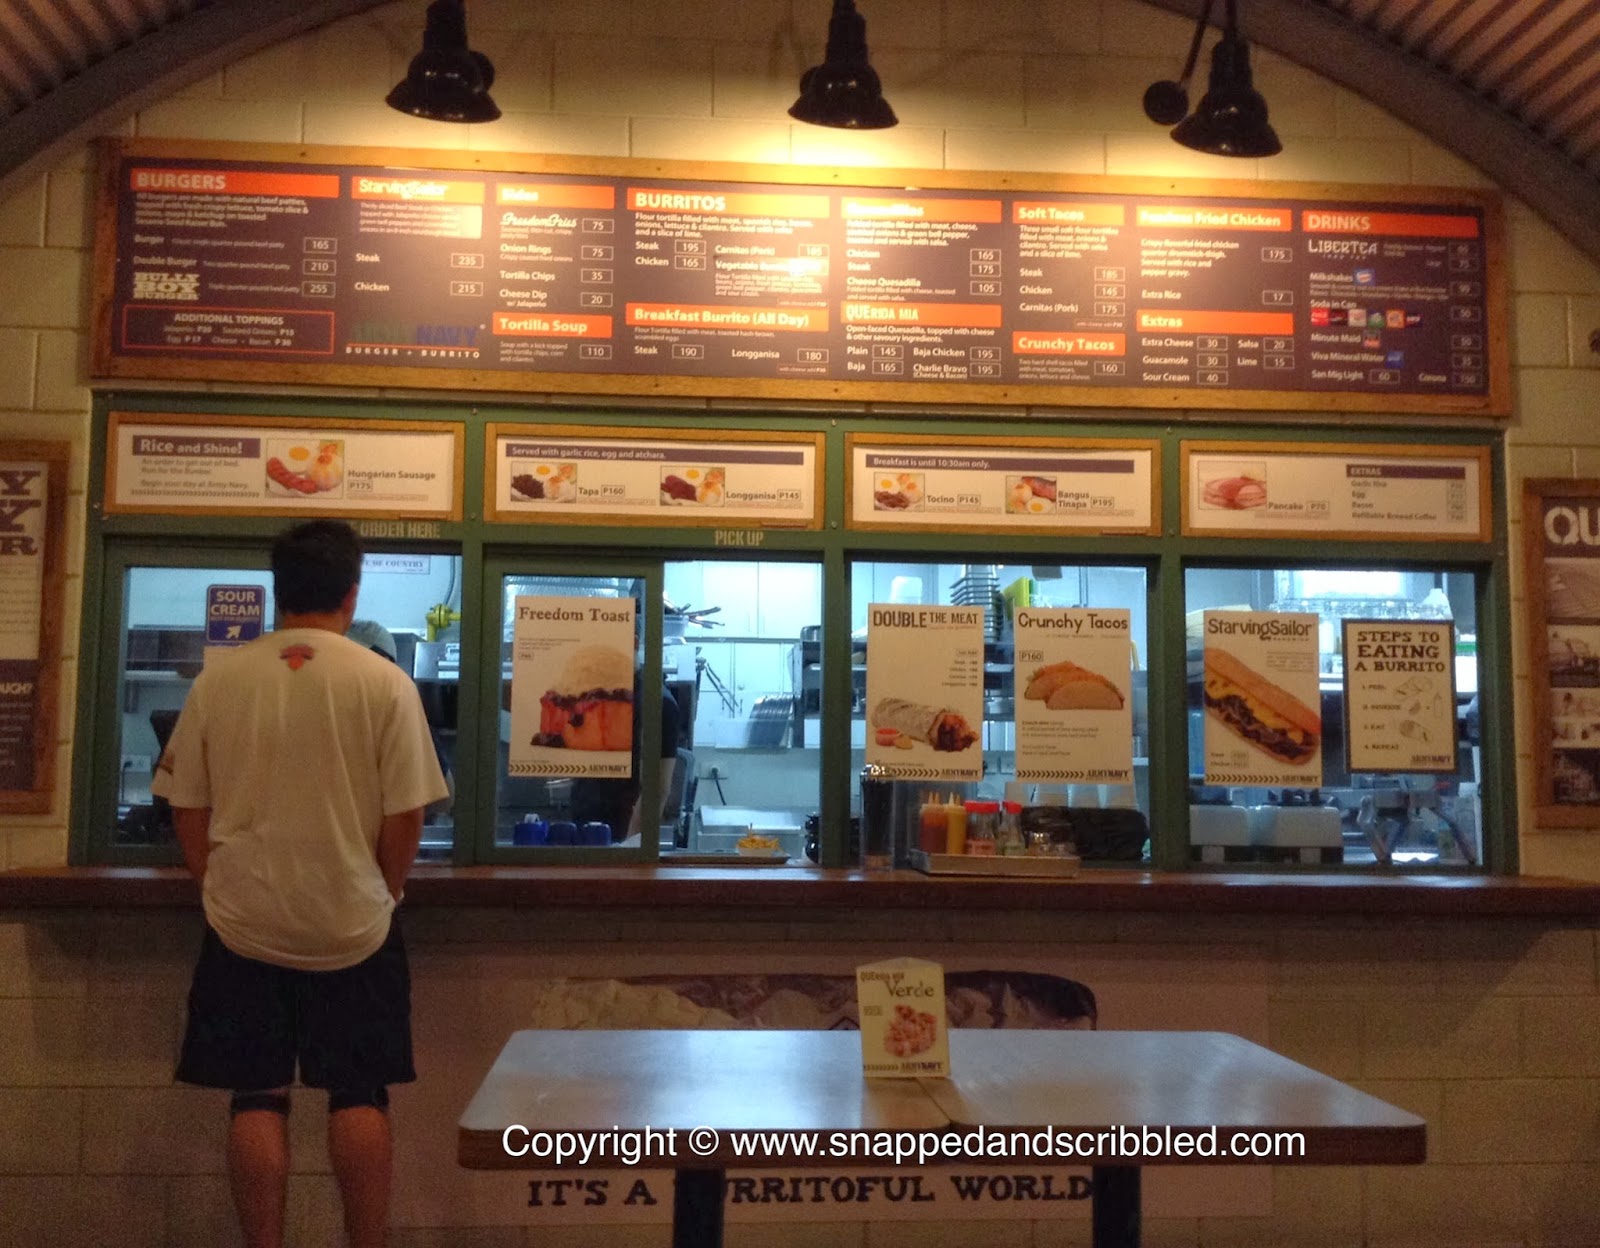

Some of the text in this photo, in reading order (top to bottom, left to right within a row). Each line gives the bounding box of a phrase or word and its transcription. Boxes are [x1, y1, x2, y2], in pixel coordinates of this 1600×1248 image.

[137, 171, 226, 190] BURGERS
[636, 193, 725, 211] BURRITOS
[636, 213, 654, 221] Flour
[656, 214, 682, 223] tortilla
[683, 214, 701, 223] filled
[703, 215, 719, 223] with
[1019, 208, 1046, 219] Soft
[1230, 213, 1280, 226] Chicken
[1309, 215, 1370, 230] DRINKS
[592, 221, 604, 230] 75
[312, 240, 329, 249] 165
[636, 242, 659, 250] Steak
[683, 243, 699, 252] 195
[1308, 239, 1377, 254] LIBERTEA
[501, 244, 552, 255] Onion Rings
[592, 248, 603, 257] 75
[1270, 250, 1284, 258] 175
[356, 254, 380, 262] Steak
[458, 256, 476, 265] 235
[978, 252, 993, 260] 165
[636, 257, 669, 266] Chicken
[683, 258, 699, 267] 165
[311, 263, 328, 271] 210
[978, 265, 994, 273] 175
[500, 271, 555, 281] Tortilla Chips
[591, 272, 603, 280] 35
[1020, 268, 1042, 277] Steak
[310, 285, 327, 293] 255
[355, 282, 389, 291] Chicken
[458, 285, 475, 293] 215
[979, 285, 994, 293] 105
[1020, 286, 1052, 294] Chicken
[500, 289, 547, 300] Cheese Dip
[1142, 290, 1181, 299] Extra Rice
[591, 295, 602, 304] 20
[1020, 303, 1078, 313] Carnitas (Pork)
[1102, 305, 1117, 314] 175
[175, 314, 284, 325] ADDITIONAL TOPPINGS
[635, 309, 809, 327] Breakfast Burrito (All Day)
[1142, 315, 1182, 327] Extras
[500, 318, 587, 334] Tortilla Soup
[1019, 338, 1114, 352] Crunchy Tacos
[1142, 338, 1193, 347] Extra Cheese
[1207, 340, 1218, 348] 30
[1274, 341, 1284, 349] 20
[422, 350, 479, 358] BURRITO
[588, 348, 604, 356] 110
[635, 346, 657, 354] Steak
[681, 348, 696, 357] 190
[732, 349, 780, 359] Longganisa
[848, 347, 868, 355] Plain
[880, 348, 896, 356] 145
[914, 348, 965, 357] Baja Chicken
[978, 350, 993, 358] 195
[806, 352, 821, 361] 180
[1143, 356, 1188, 365] Guacamole
[1207, 357, 1218, 365] 30
[848, 362, 865, 372] Baja
[880, 363, 896, 371] 165
[914, 364, 967, 373] Charlie Bravo
[978, 366, 993, 374] 195
[1102, 365, 1117, 373] 160
[1143, 373, 1189, 381] Sour Cream
[1207, 374, 1218, 382] 40
[141, 439, 242, 454] Rice and Shine!
[512, 447, 540, 455] Served
[541, 448, 559, 456] with
[561, 449, 582, 458] garlic
[584, 449, 600, 458] rice,
[874, 458, 908, 466] Breakfast
[972, 460, 989, 469] only.
[348, 470, 435, 480] Hungarian Sausage
[579, 488, 599, 496] Tapa
[726, 492, 776, 501] Longganisa
[1058, 491, 1089, 499] Bangus
[927, 495, 954, 503] Tocino
[1058, 501, 1086, 509] Tinapa
[1268, 502, 1303, 511] Pancake
[361, 521, 440, 538] ORDER HERE
[715, 531, 764, 546] PICK UP
[217, 591, 255, 602] SOUR
[211, 605, 259, 615] CREAM
[519, 607, 630, 622] Freedom Toast
[873, 611, 978, 628] DOUBLE THE MEAT
[1018, 613, 1128, 633] Crunchy Tacos
[1357, 631, 1439, 643] STEPS TO
[1358, 645, 1439, 658] EATING
[1355, 662, 1445, 672] A BURRITO
[885, 980, 934, 997] Verde
[528, 1175, 1093, 1208] IT'S A RRITOFUL WORLD
